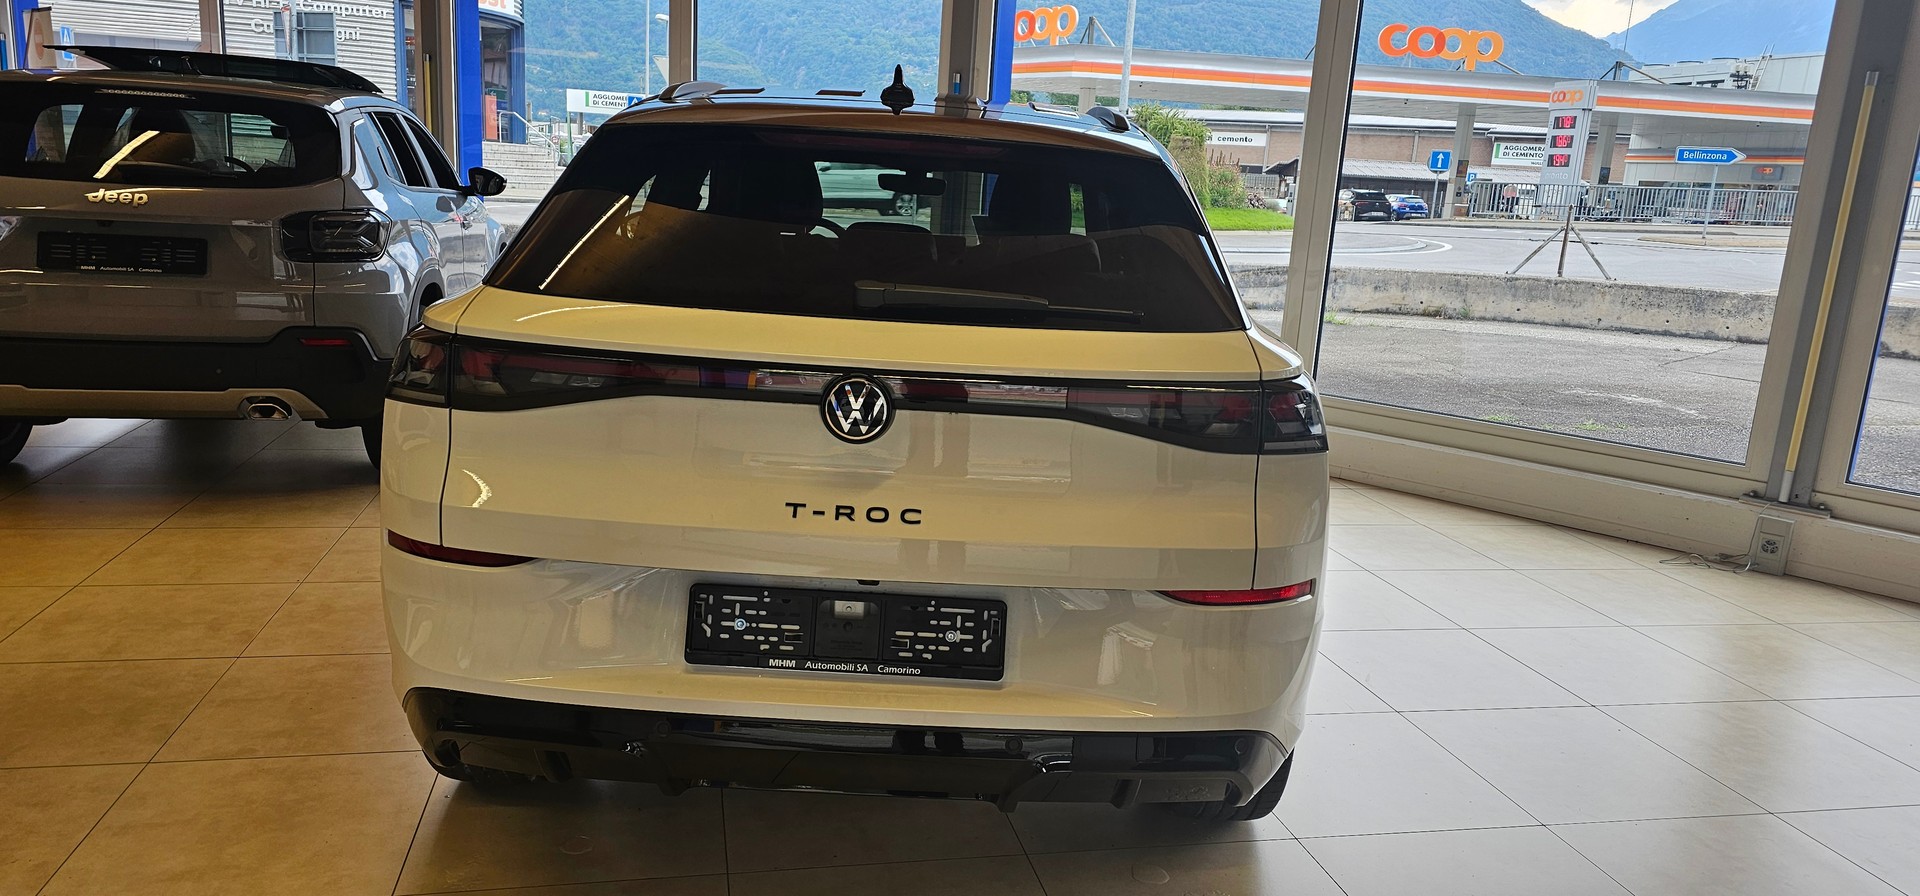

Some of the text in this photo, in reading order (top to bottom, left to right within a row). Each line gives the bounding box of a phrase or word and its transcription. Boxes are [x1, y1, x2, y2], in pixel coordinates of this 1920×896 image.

[1378, 23, 1504, 72] coop
[1551, 90, 1584, 105] coop
[1683, 151, 1728, 160] Bellinzona
[84, 188, 149, 207] Jeep
[785, 502, 922, 525] T-ROC
[769, 658, 796, 668] MHM
[804, 661, 854, 671] Automobili
[877, 665, 921, 674] Camorino
